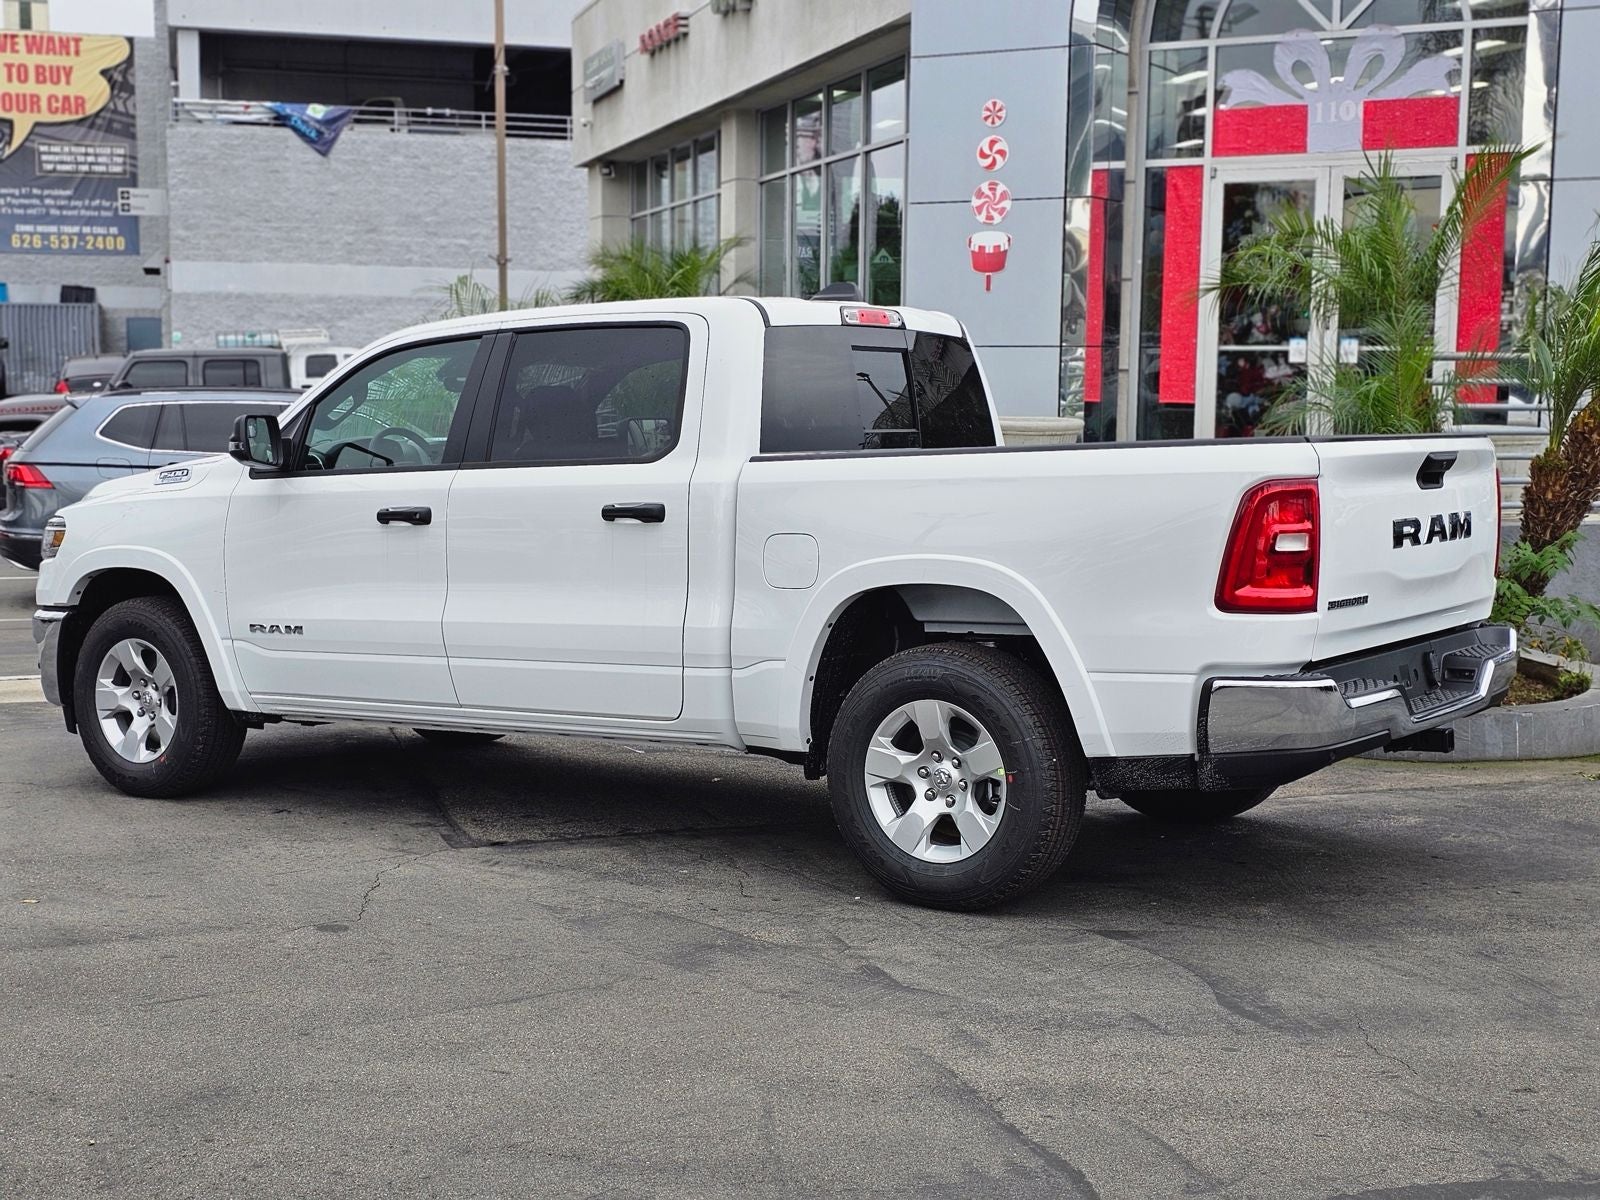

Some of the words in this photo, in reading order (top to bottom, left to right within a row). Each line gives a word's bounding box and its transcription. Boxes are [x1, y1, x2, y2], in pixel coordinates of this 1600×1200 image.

[24, 35, 81, 56] WANT
[4, 63, 28, 83] TO
[35, 64, 72, 85] BUY
[0, 92, 41, 113] OUR
[47, 94, 86, 115] CAR
[1316, 100, 1364, 122] 110
[11, 233, 126, 250] 626-537-2400
[0, 404, 59, 415] MOJAV
[1392, 511, 1472, 549] RAM
[249, 623, 304, 635] RAM
